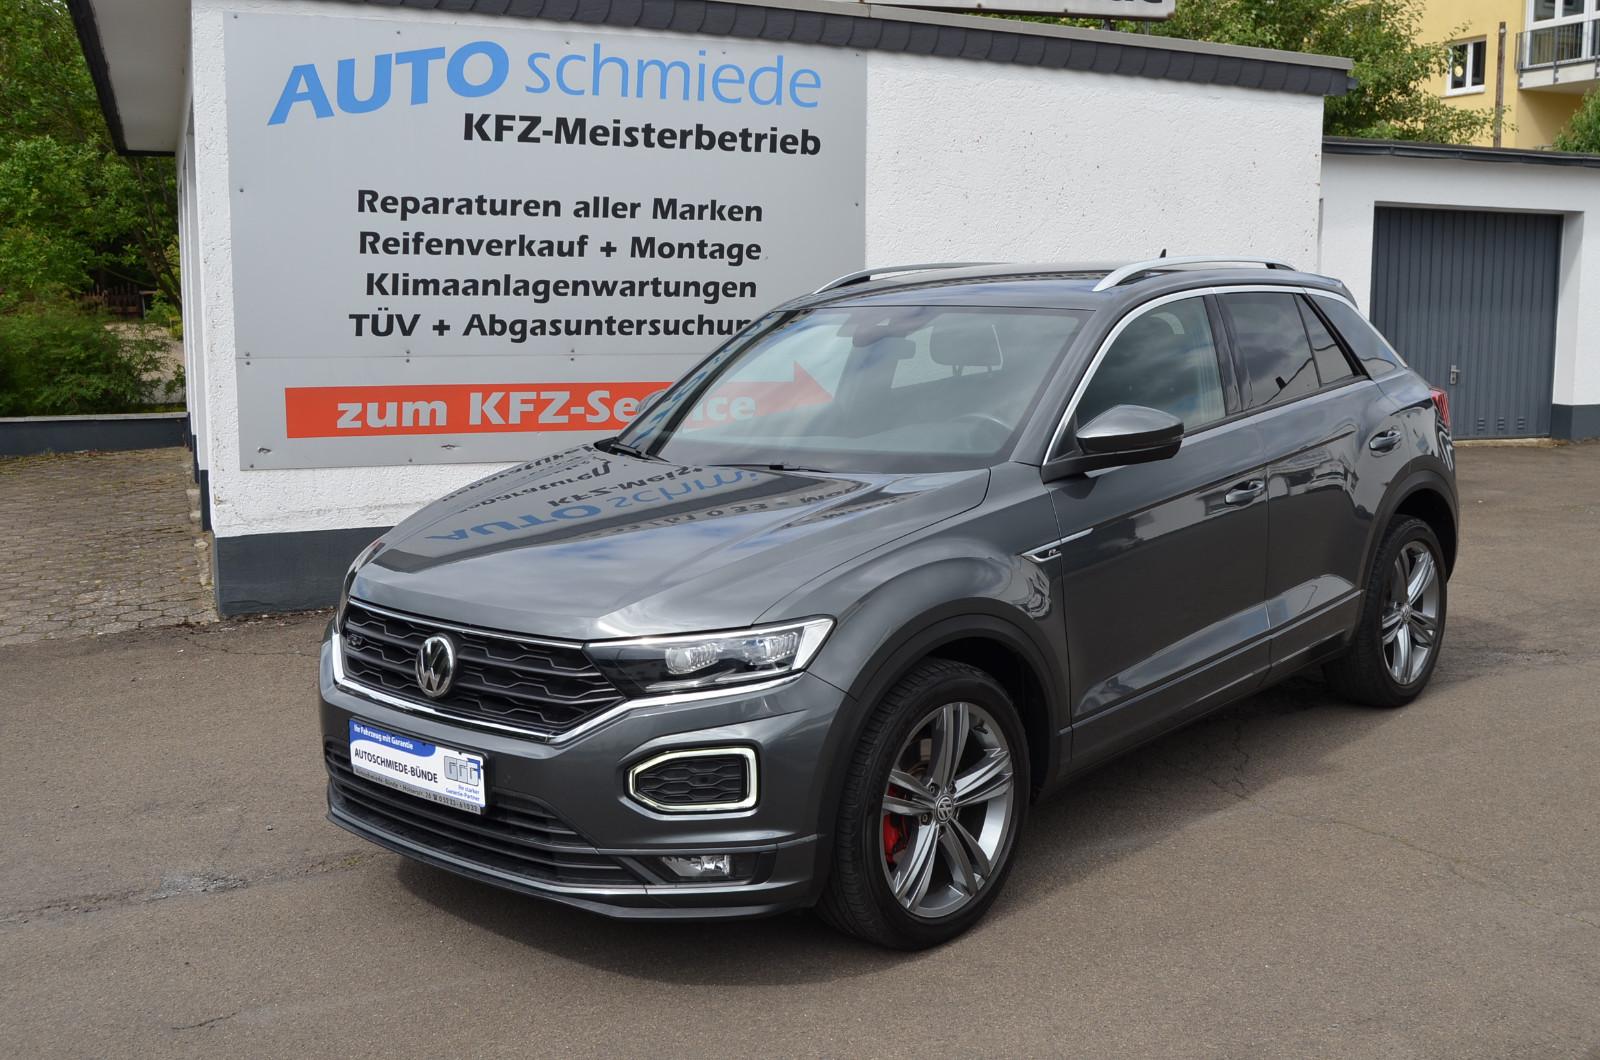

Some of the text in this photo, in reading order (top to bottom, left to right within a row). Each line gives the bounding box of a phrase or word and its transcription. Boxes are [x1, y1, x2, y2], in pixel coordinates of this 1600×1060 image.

[268, 40, 823, 127] AUTO schmiede
[463, 112, 821, 156] KFZ-Meisterbetrieb
[357, 189, 763, 222] Reparaturen aller Marken
[359, 231, 589, 258] Reifenverkauf
[630, 236, 762, 267] Montage
[366, 272, 757, 303] Klimaanlagenwartungen
[349, 307, 421, 337] TÜV
[336, 401, 448, 429] zum
[360, 726, 382, 742] Fahrzeug
[382, 734, 391, 743] mit
[391, 736, 414, 750] Garantie
[354, 746, 439, 783] AUTOSCHMIEDE-BÜNDE
